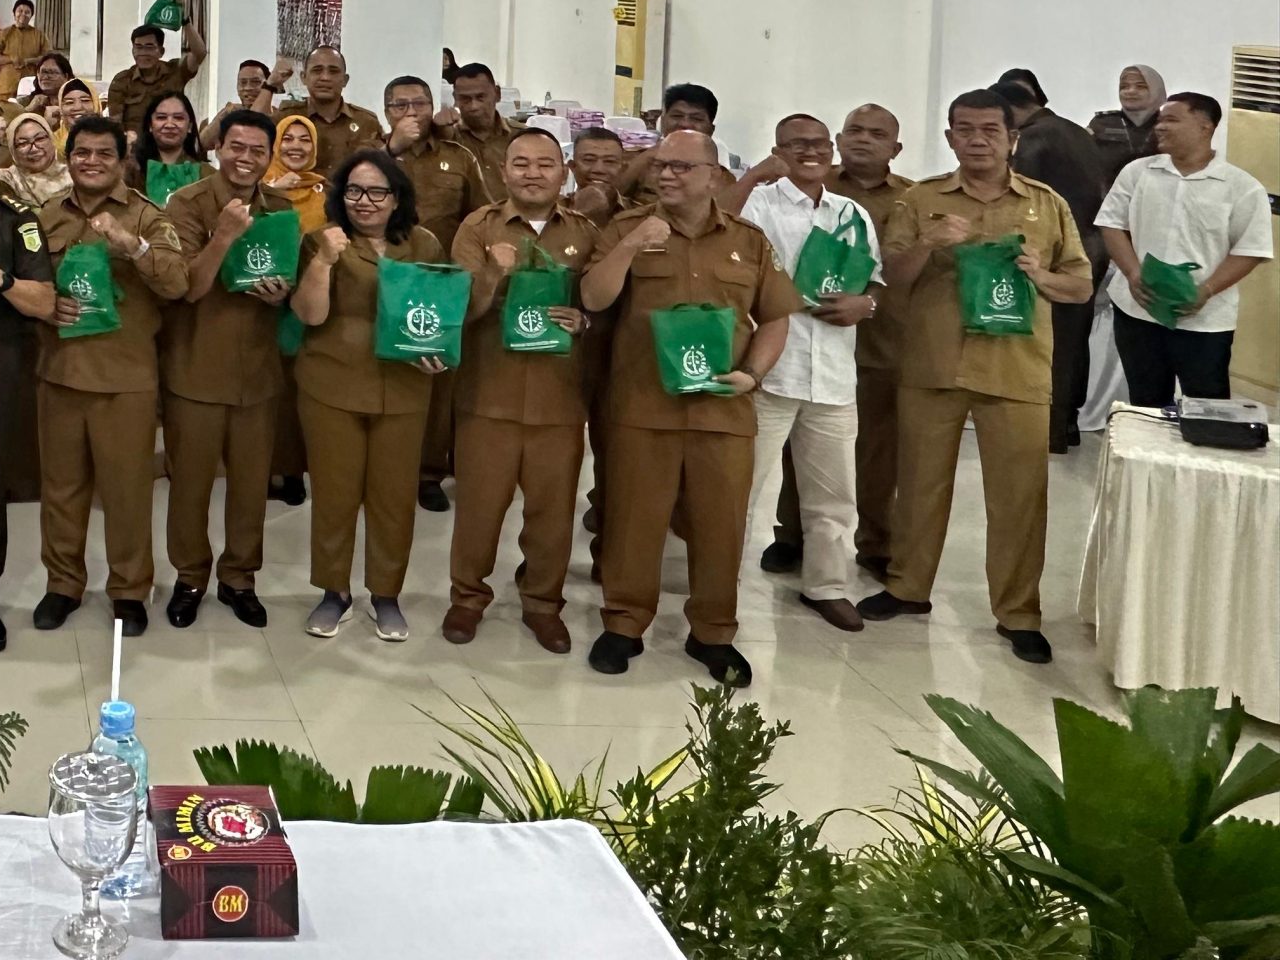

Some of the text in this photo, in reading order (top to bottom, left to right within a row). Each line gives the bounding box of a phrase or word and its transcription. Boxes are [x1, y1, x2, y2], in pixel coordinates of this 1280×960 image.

[176, 794, 204, 833] MIMIN
[187, 835, 217, 852] BU
[219, 894, 243, 913] BM
